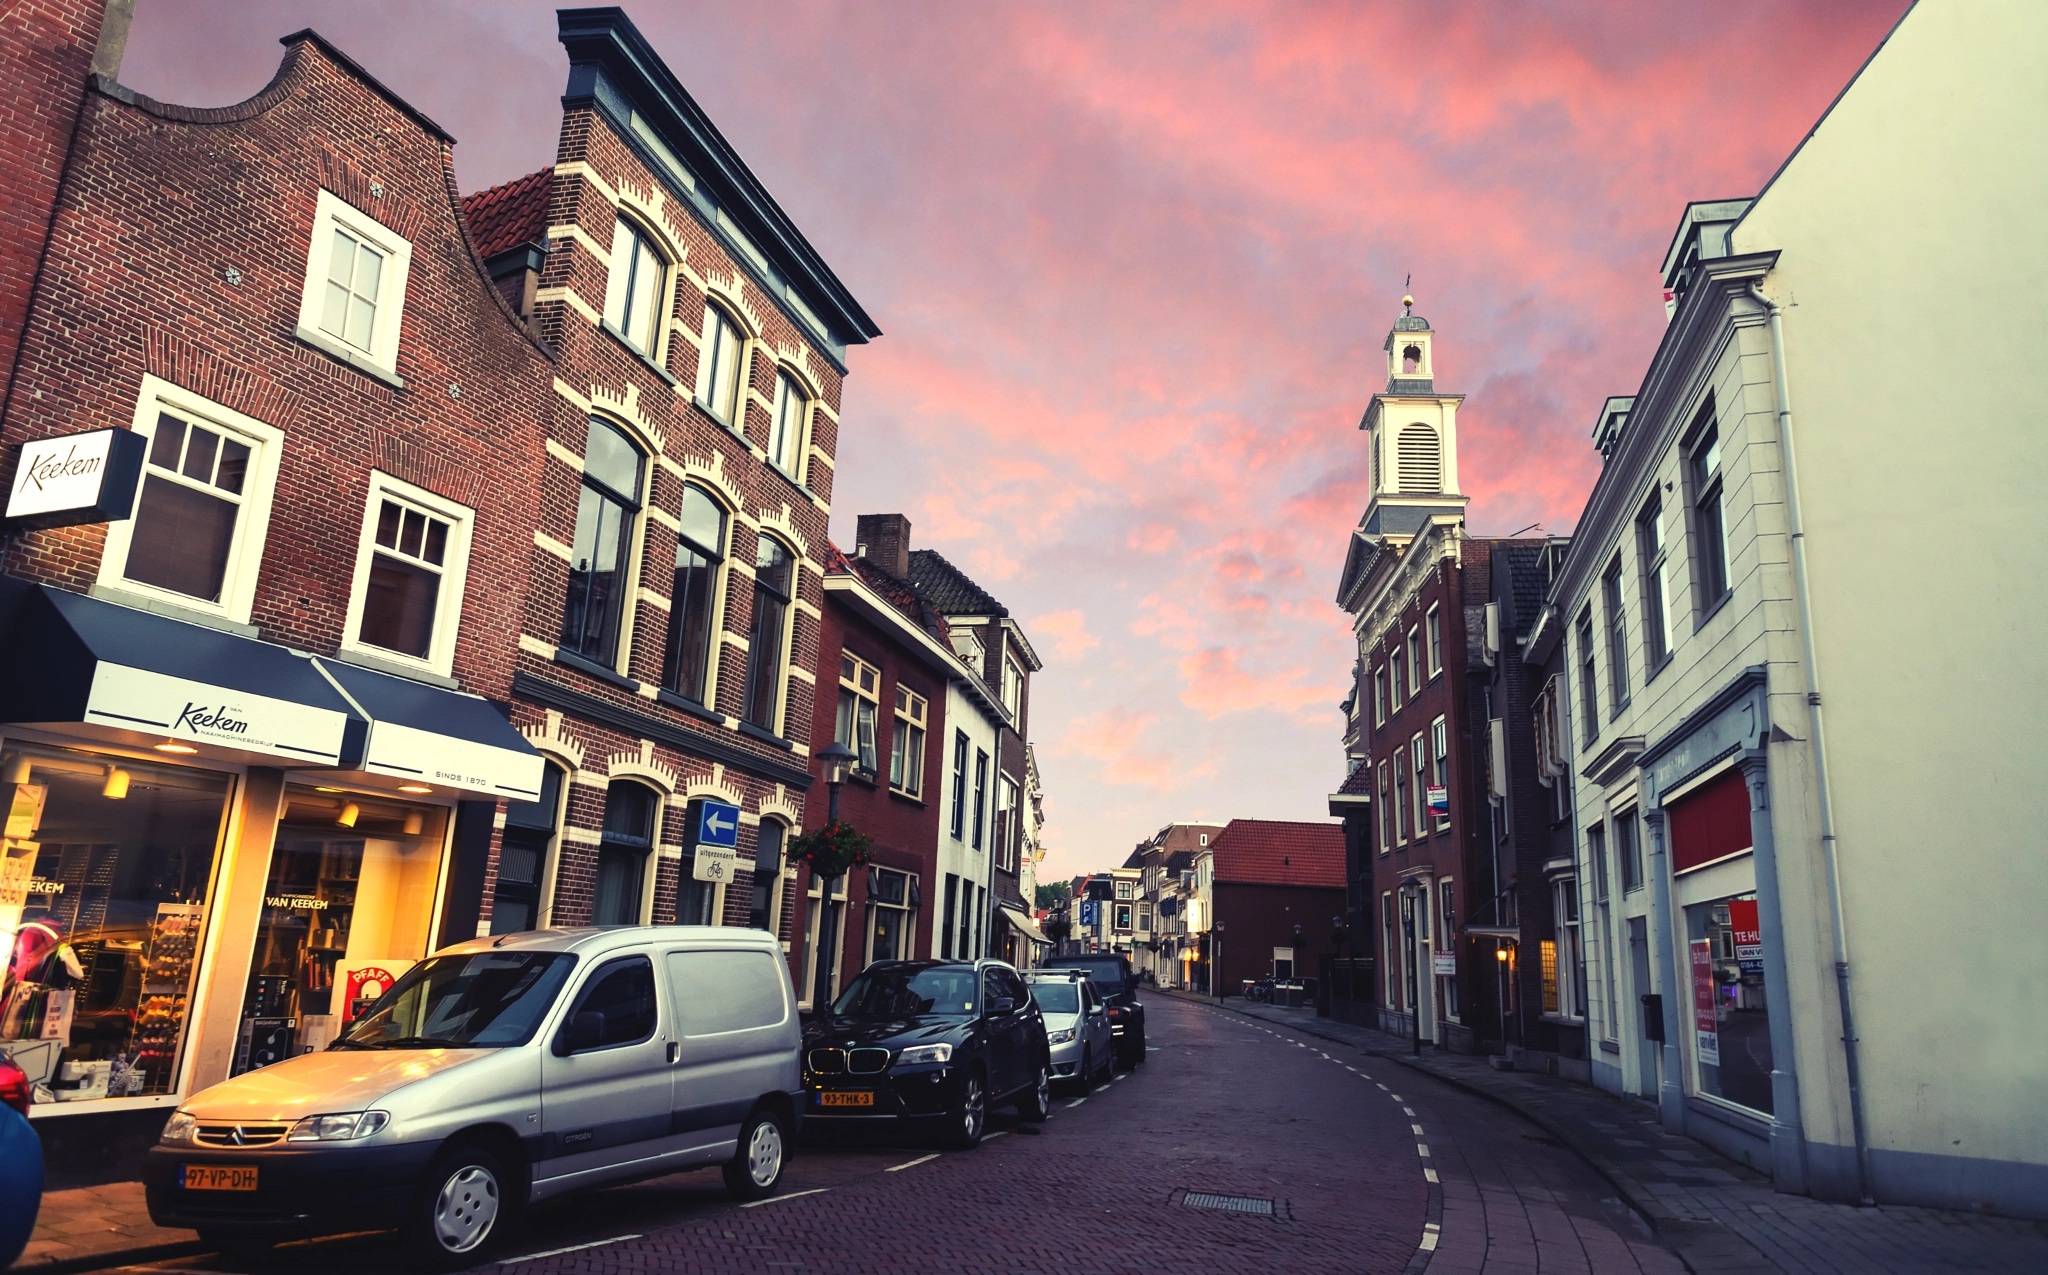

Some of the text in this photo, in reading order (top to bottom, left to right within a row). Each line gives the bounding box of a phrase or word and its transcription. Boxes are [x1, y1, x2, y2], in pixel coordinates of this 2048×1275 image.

[19, 444, 101, 493] Keekem
[229, 706, 243, 714] VAN
[173, 701, 248, 734] Keekem
[200, 730, 274, 747] NAAIMACHINEBEDRIJF
[435, 771, 487, 786] SINDS 1870
[700, 850, 734, 860] uitgezonderd
[265, 896, 289, 908] VAN
[290, 898, 329, 910] KEEKEM
[1083, 904, 1091, 916] P
[1735, 930, 1761, 942] TE HU
[1740, 949, 1755, 957] VAN
[1740, 961, 1764, 969] 0184-42
[352, 968, 390, 983] PFAFF
[824, 1093, 870, 1105] 93-THK-3
[188, 1168, 254, 1188] 97-VP-DH
